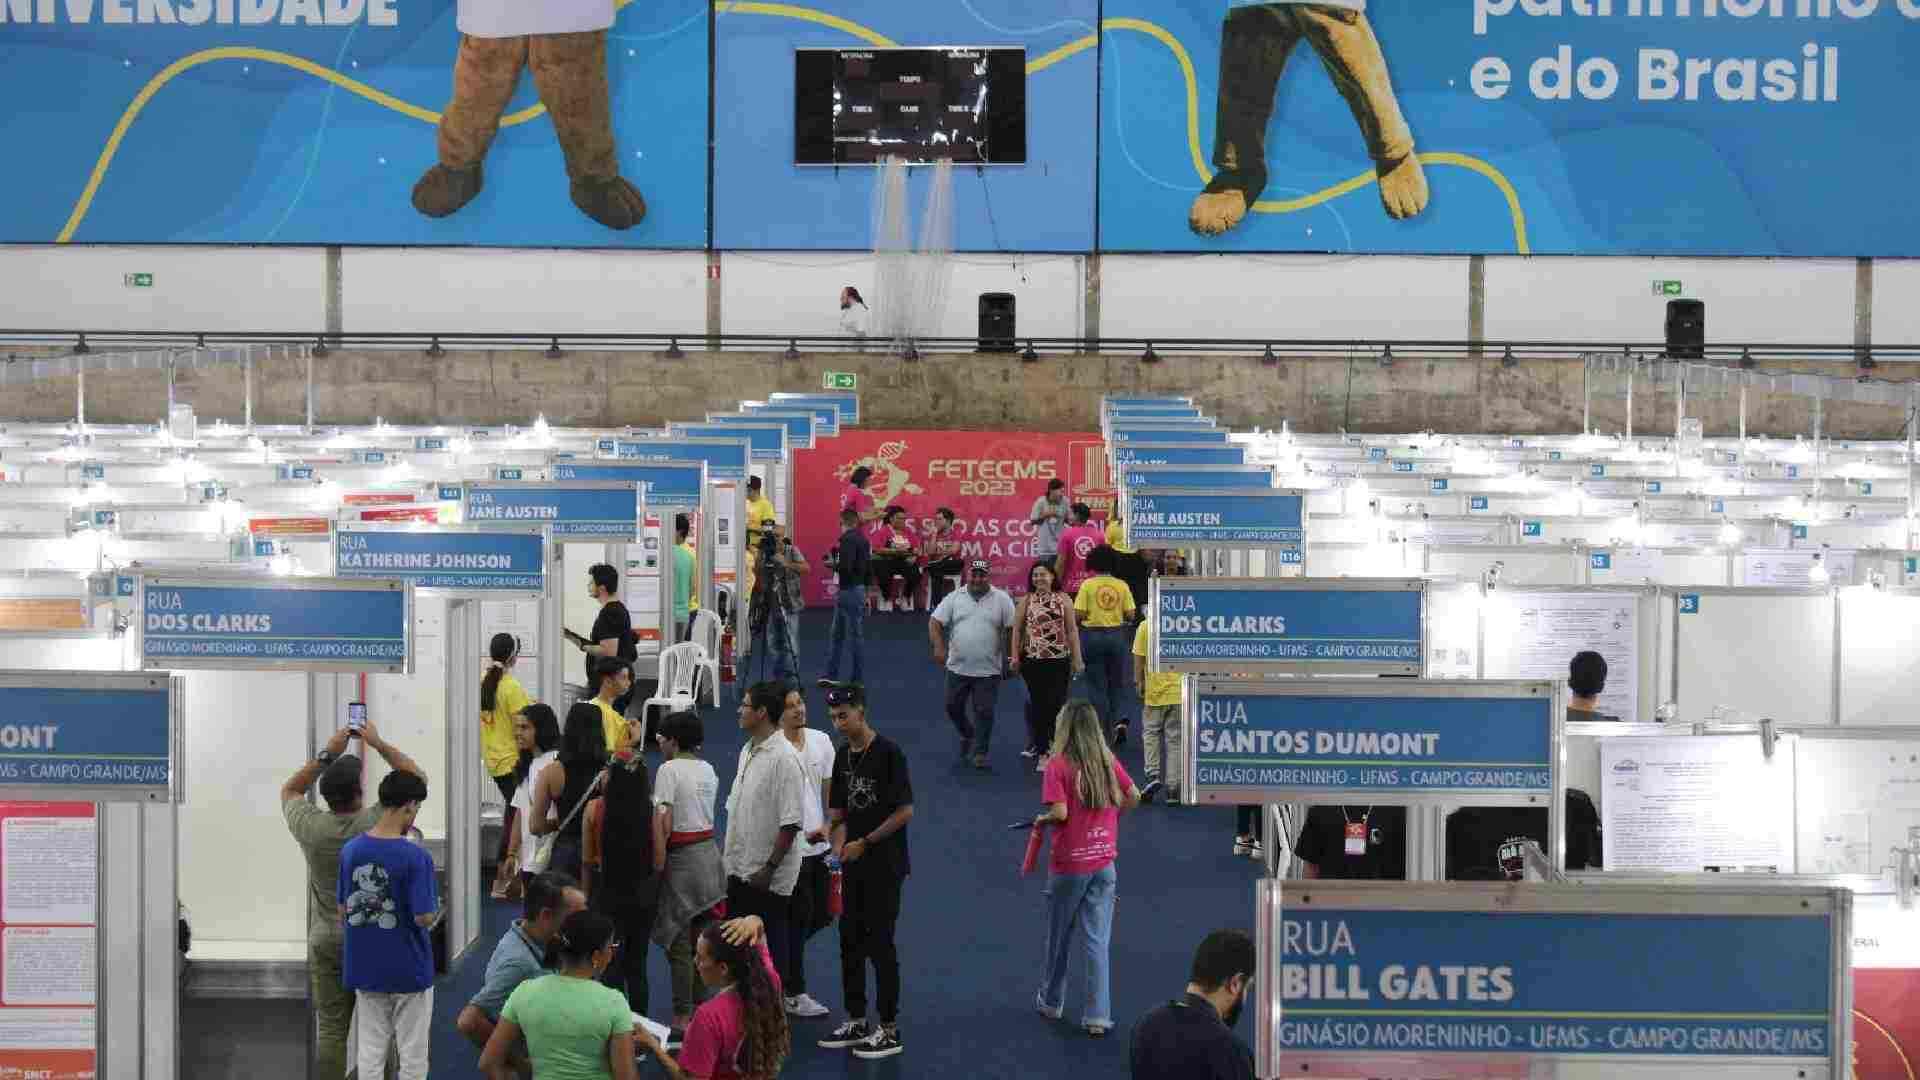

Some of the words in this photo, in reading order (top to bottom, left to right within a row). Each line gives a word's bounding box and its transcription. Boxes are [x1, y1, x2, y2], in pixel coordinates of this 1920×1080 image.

[1470, 56, 1511, 99] e
[1529, 45, 1618, 99] do
[1637, 42, 1838, 101] Brasil
[928, 460, 1056, 480] FETECMS
[959, 481, 1016, 497] 2023
[469, 506, 503, 519] JANE
[505, 507, 558, 519] AUSTEN
[1131, 513, 1165, 525] JANE
[1168, 513, 1220, 525] AUSTEN
[973, 519, 1000, 537] AS
[339, 535, 368, 549] RUA
[339, 553, 432, 568] KATHERINE
[433, 554, 511, 569] JOHNSON
[148, 591, 183, 609] RUA
[1160, 595, 1196, 611] RUA
[148, 613, 188, 631] DOS
[193, 614, 272, 632] CLARKS
[1161, 616, 1202, 633] DOS
[1206, 616, 1286, 633] CLARKS
[266, 642, 294, 655] UFMS
[303, 643, 341, 656] CAMPO
[1280, 644, 1308, 657] UFMS
[1317, 645, 1354, 657] CAMPO
[1200, 700, 1248, 724] RUA
[0, 724, 58, 750] ONT
[1200, 730, 1309, 754] SANTOS
[1316, 732, 1440, 756] DUMONT
[30, 763, 80, 779] CAMPO
[84, 763, 167, 782] GRANDE/MS
[1200, 765, 1257, 785] GINÁSIO
[1260, 768, 1347, 785] MORENINHO
[1360, 768, 1399, 786] UFMS
[1411, 769, 1461, 787] CAMPO
[1464, 770, 1549, 788] GRANDE/MS
[1283, 921, 1355, 954] RUA
[1282, 966, 1367, 999] BILL
[1379, 966, 1514, 1001] GATES
[1280, 1018, 1369, 1046] GINÁSIO
[1374, 1023, 1511, 1047] MORENINHO
[1530, 1024, 1589, 1048] UFMS
[1608, 1026, 1688, 1049] CAMPO
[1692, 1026, 1825, 1051] GRANDE/MS
